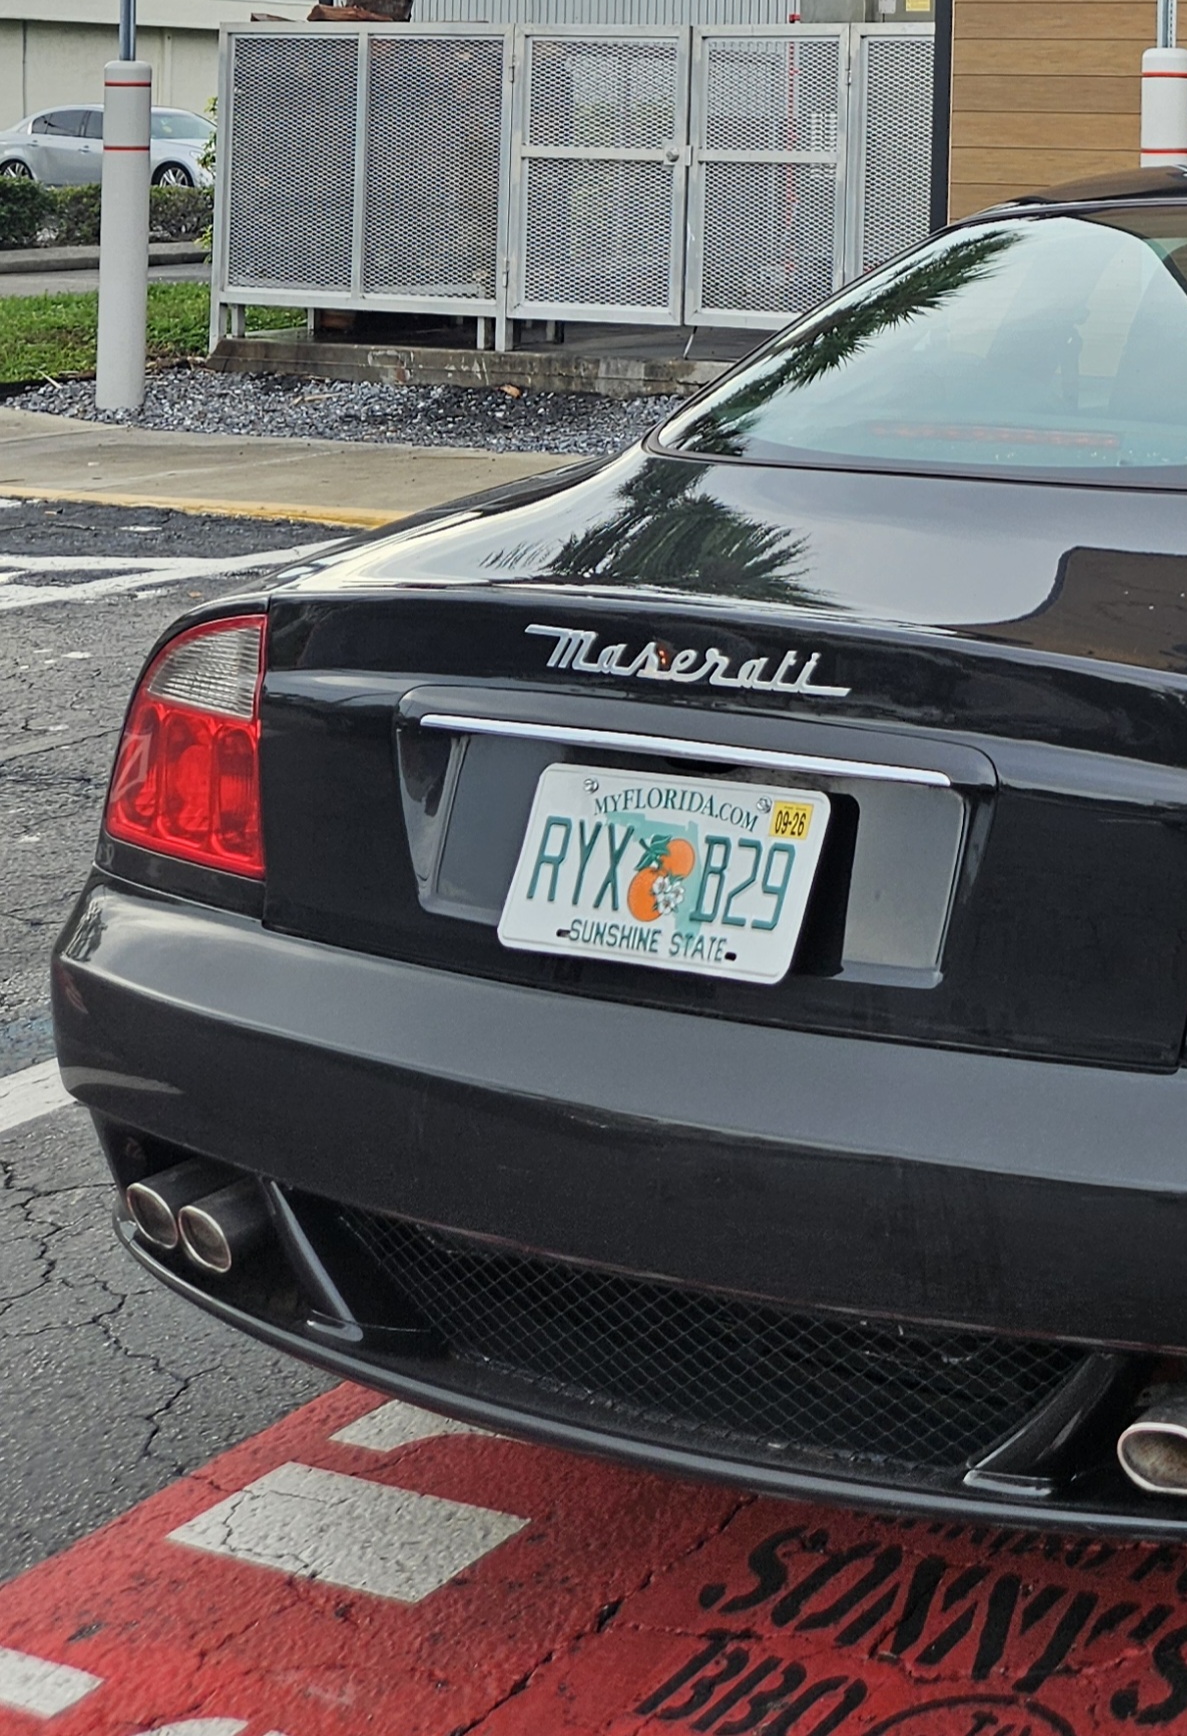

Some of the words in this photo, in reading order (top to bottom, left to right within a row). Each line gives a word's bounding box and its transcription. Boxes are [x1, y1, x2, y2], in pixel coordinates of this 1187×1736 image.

[524, 623, 852, 697] Maserati
[594, 787, 759, 833] MYFLORIDA.COM
[775, 810, 807, 837] 09-26
[526, 815, 635, 912] RYX
[688, 834, 796, 932] B29
[569, 919, 662, 953] SUNSHINE
[668, 931, 727, 963] STATE
